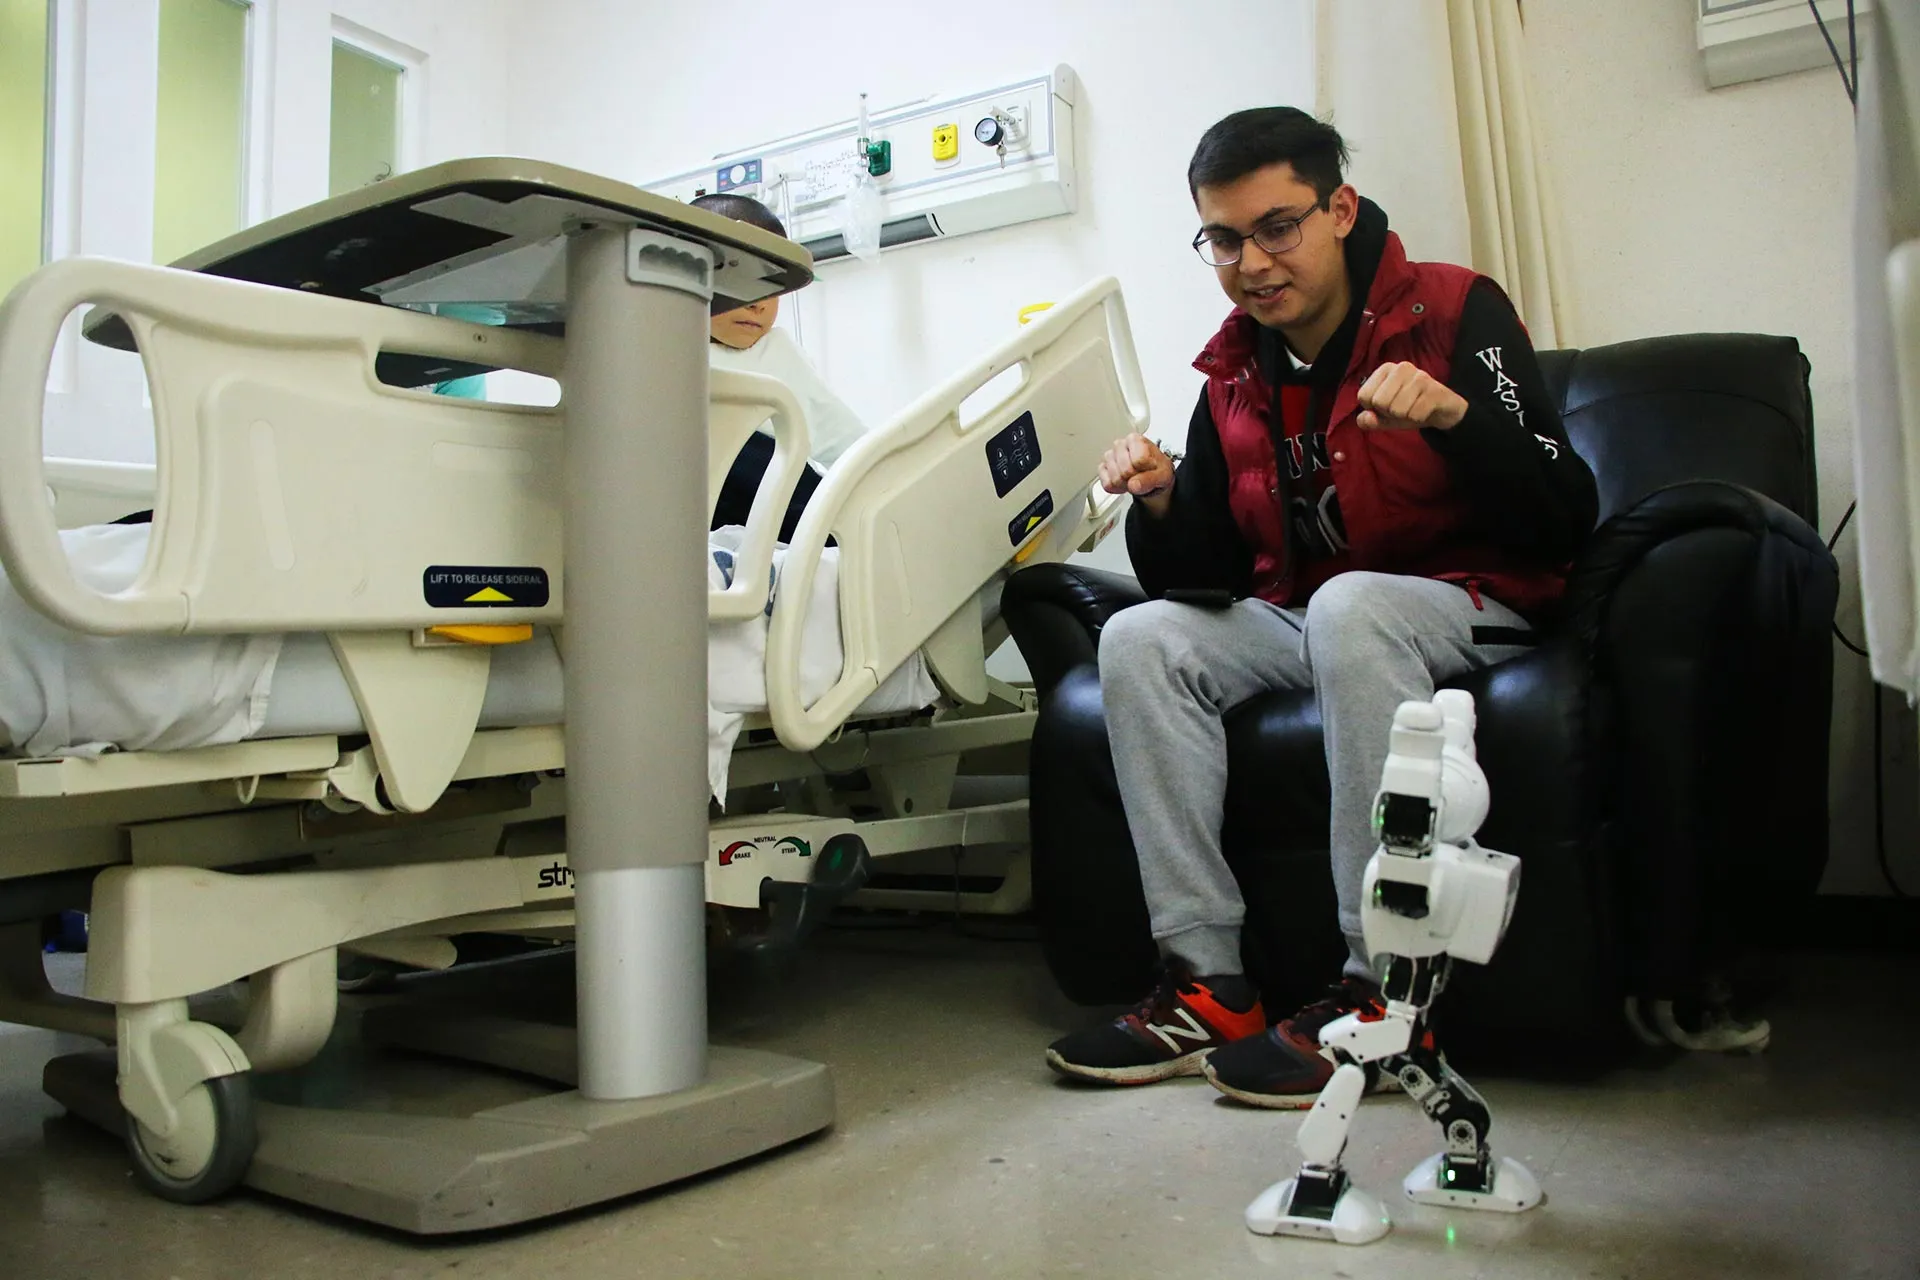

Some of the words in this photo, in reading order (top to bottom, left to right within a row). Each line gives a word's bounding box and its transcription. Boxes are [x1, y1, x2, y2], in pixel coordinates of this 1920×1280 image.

[430, 574, 448, 584] LIFT
[451, 574, 463, 584] TO
[465, 574, 504, 585] RELEASE
[505, 575, 542, 585] SIDERAIL
[753, 835, 777, 843] NEUTRAL
[734, 851, 751, 860] BRAKE
